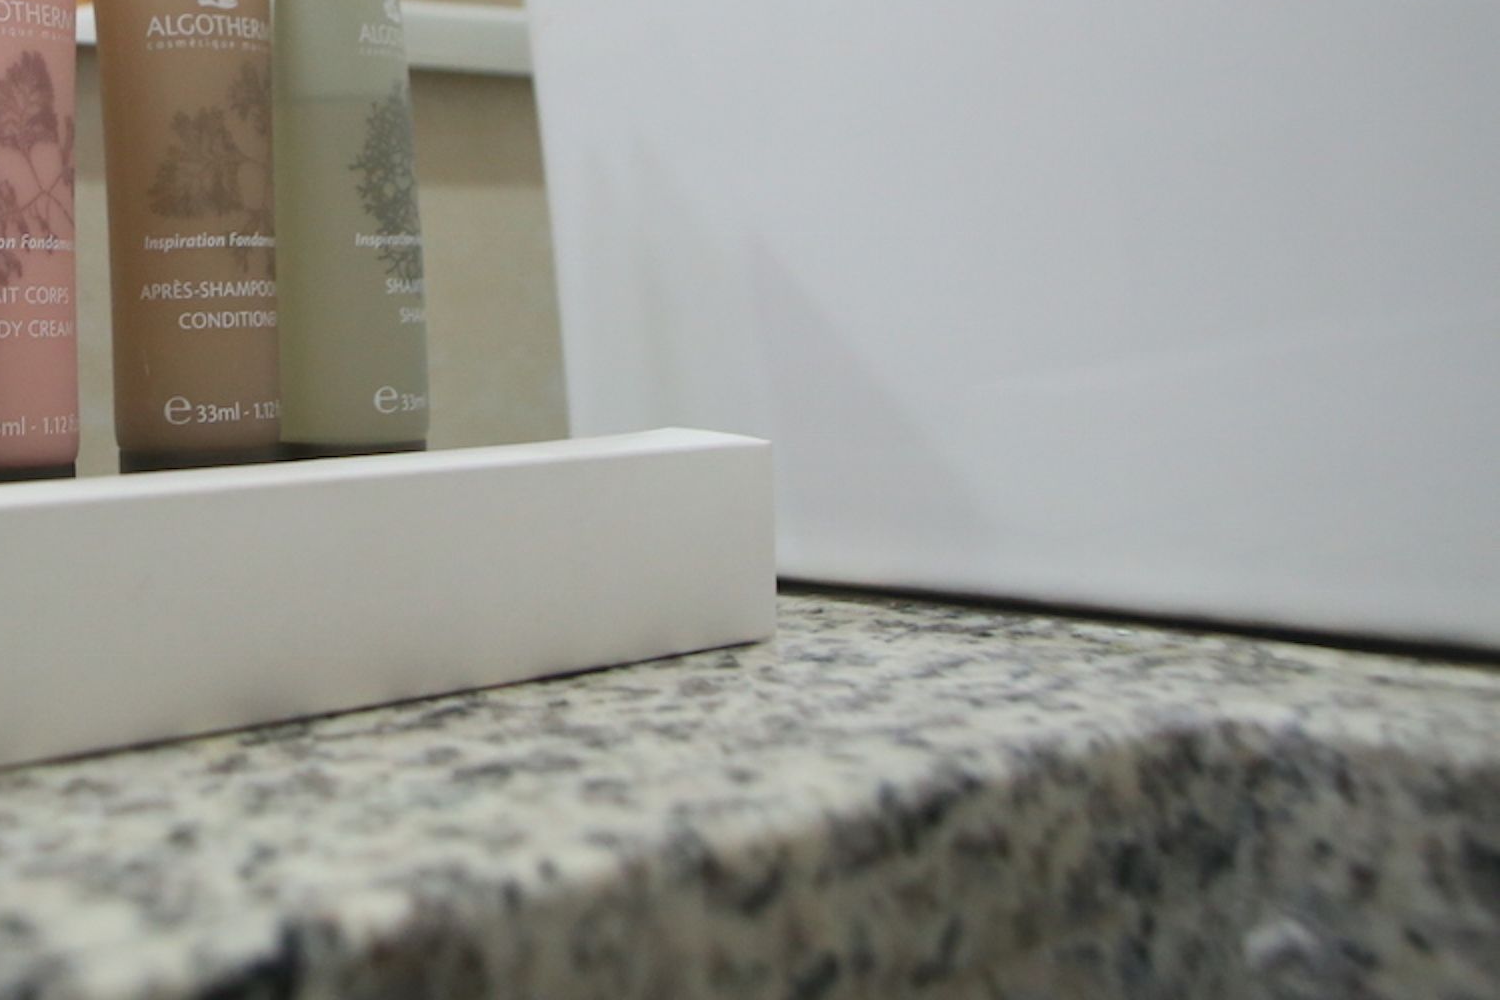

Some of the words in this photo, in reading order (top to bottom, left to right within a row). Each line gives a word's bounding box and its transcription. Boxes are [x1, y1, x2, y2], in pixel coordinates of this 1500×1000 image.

[144, 232, 225, 253] Inspiration
[25, 286, 69, 304] CORPS
[196, 402, 241, 423] 33ml
